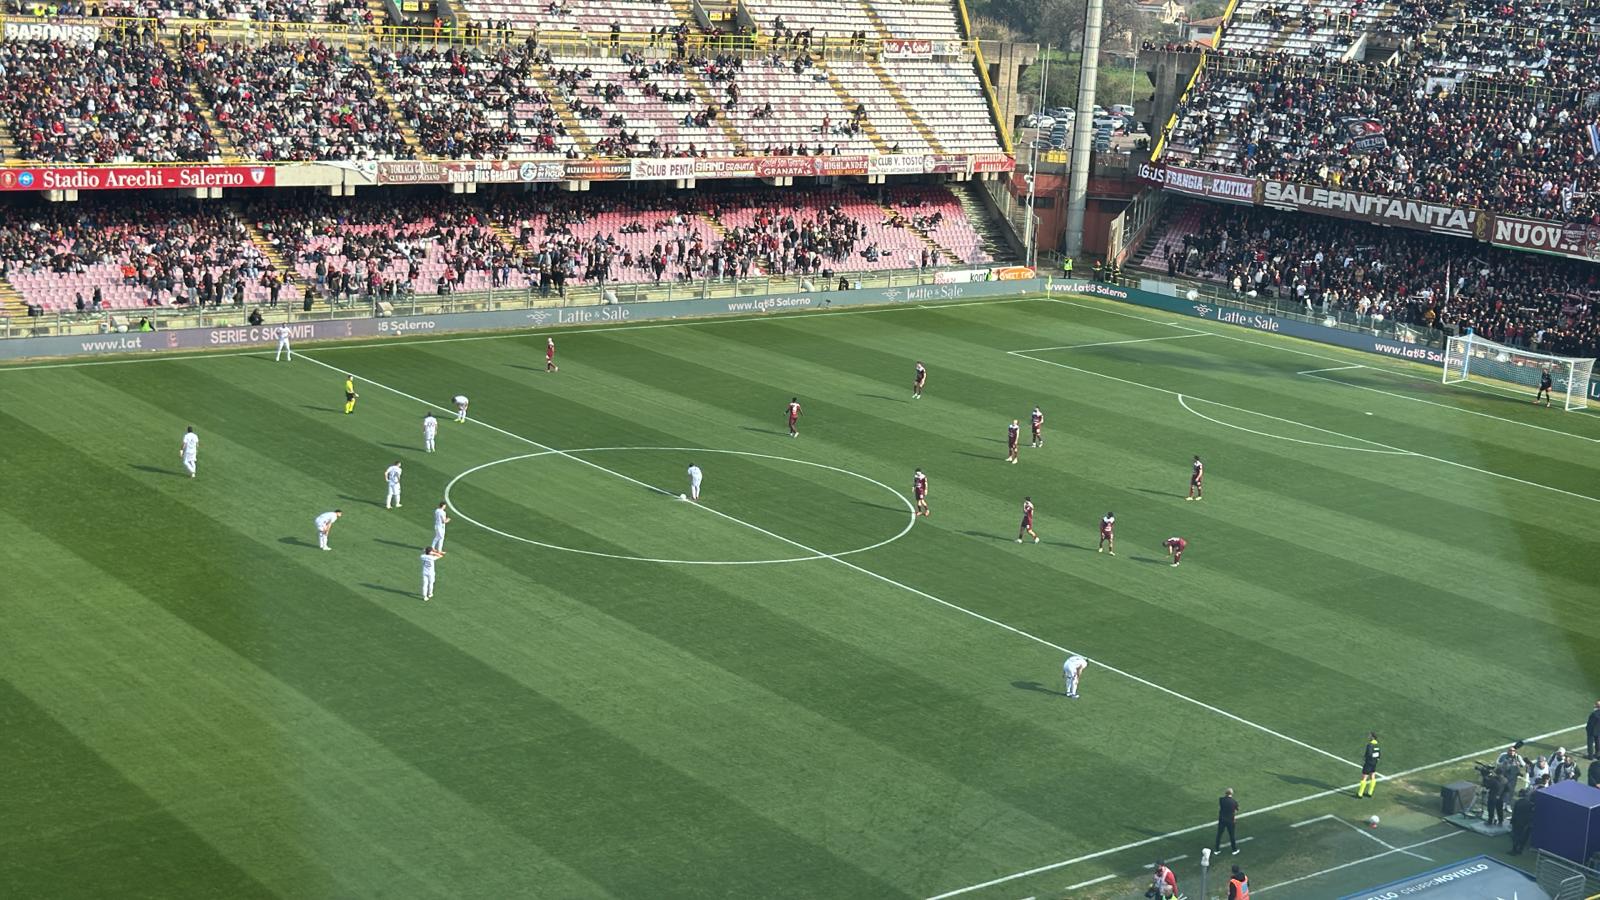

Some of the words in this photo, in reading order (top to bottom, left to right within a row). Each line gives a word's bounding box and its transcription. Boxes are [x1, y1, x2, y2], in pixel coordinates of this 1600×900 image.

[695, 162, 725, 172] SIANO
[725, 162, 754, 171] GRANATA
[823, 161, 868, 170] HIGHLANDER
[878, 157, 893, 166] CLUB
[646, 164, 667, 176] CLUB
[670, 163, 694, 175] PENTA
[764, 168, 804, 176] GRANATA
[43, 170, 99, 188] Stadio
[105, 170, 162, 187] Arechi
[180, 169, 244, 185] Salerno
[1165, 169, 1203, 191] FRANGIA
[1213, 178, 1253, 198] KAOTIKA
[941, 285, 963, 298] Sale
[1096, 285, 1128, 299] Salerno
[776, 297, 811, 307] Salerno
[558, 309, 592, 324] Latte
[602, 307, 630, 322] Sale
[1217, 307, 1247, 325] Latte
[1254, 317, 1280, 332] Sale
[390, 320, 436, 331] Salerno
[210, 329, 247, 344] SERIE
[249, 328, 259, 341] C
[262, 326, 281, 341] SK
[1433, 863, 1489, 884] NOVIELLO
